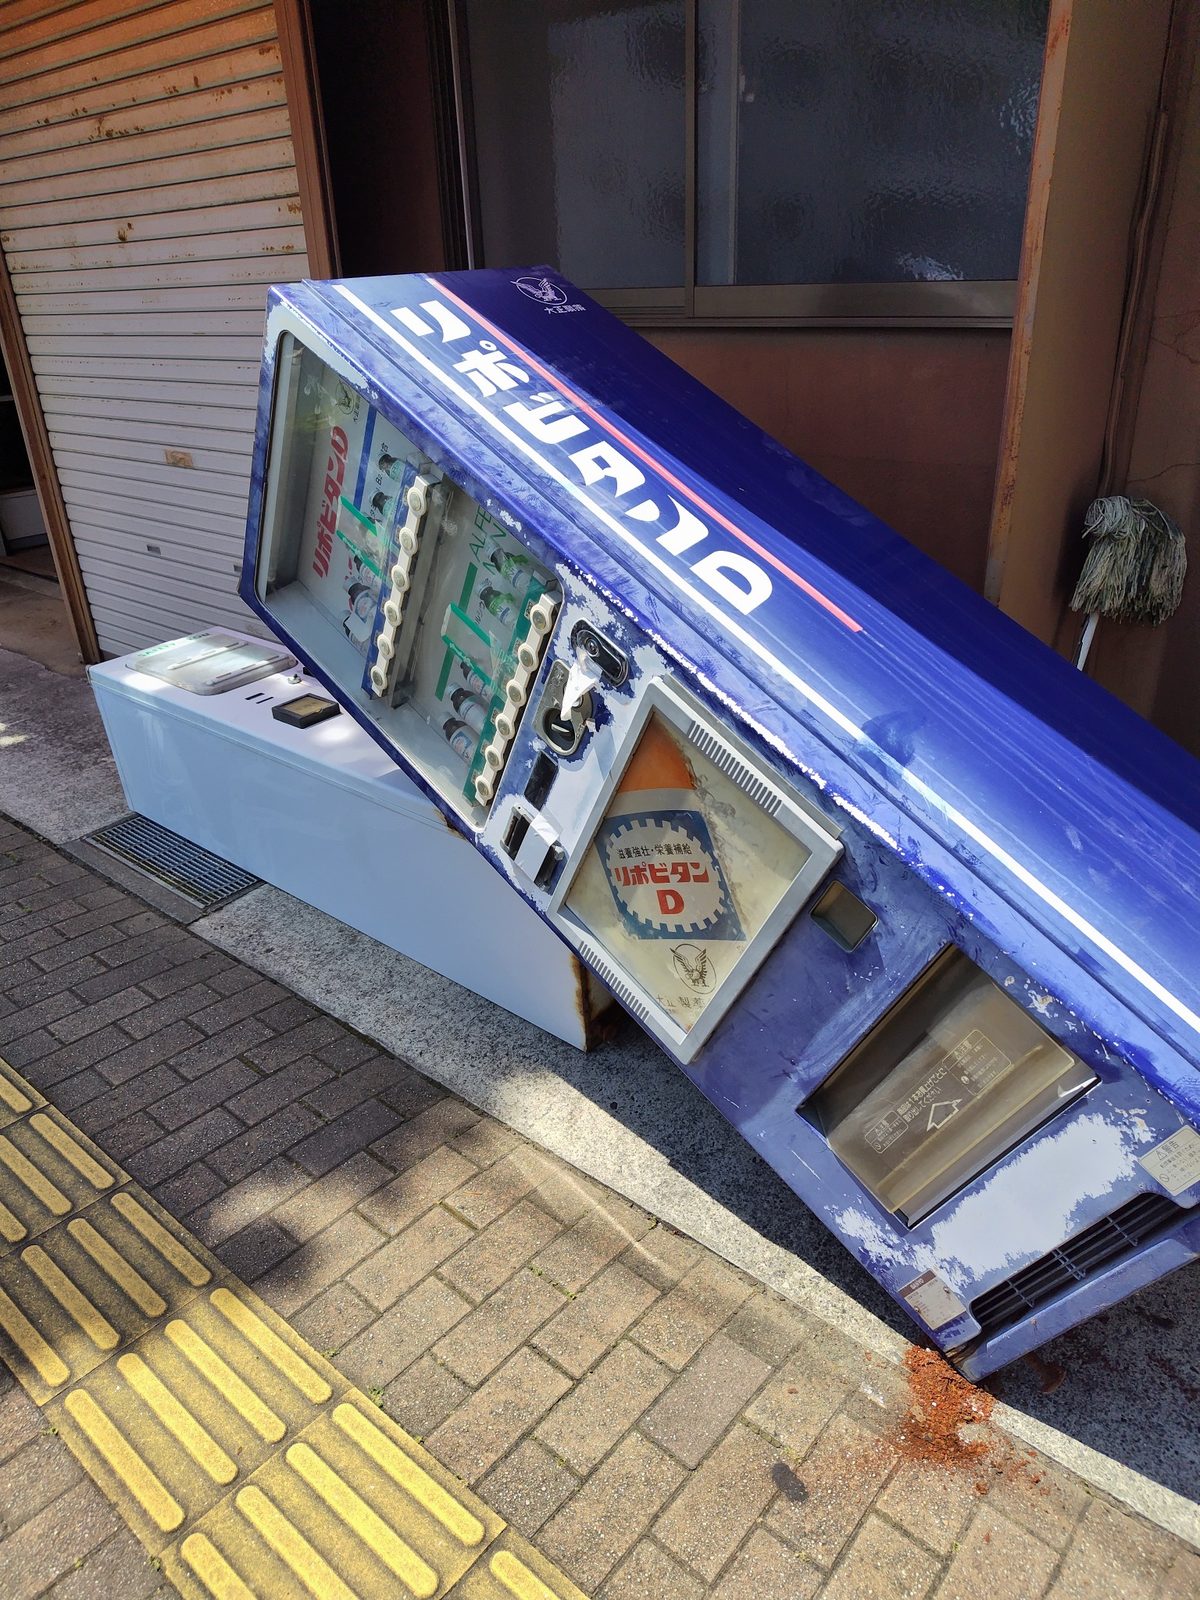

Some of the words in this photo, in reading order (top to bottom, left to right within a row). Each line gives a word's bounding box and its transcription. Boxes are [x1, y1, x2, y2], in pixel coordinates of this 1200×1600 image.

[390, 300, 773, 616] リポビタンD
[313, 425, 349, 579] リポビタンD
[617, 843, 692, 860] 滋養強壮・栄養補給
[614, 861, 710, 887] リポビタン
[656, 889, 685, 915] D
